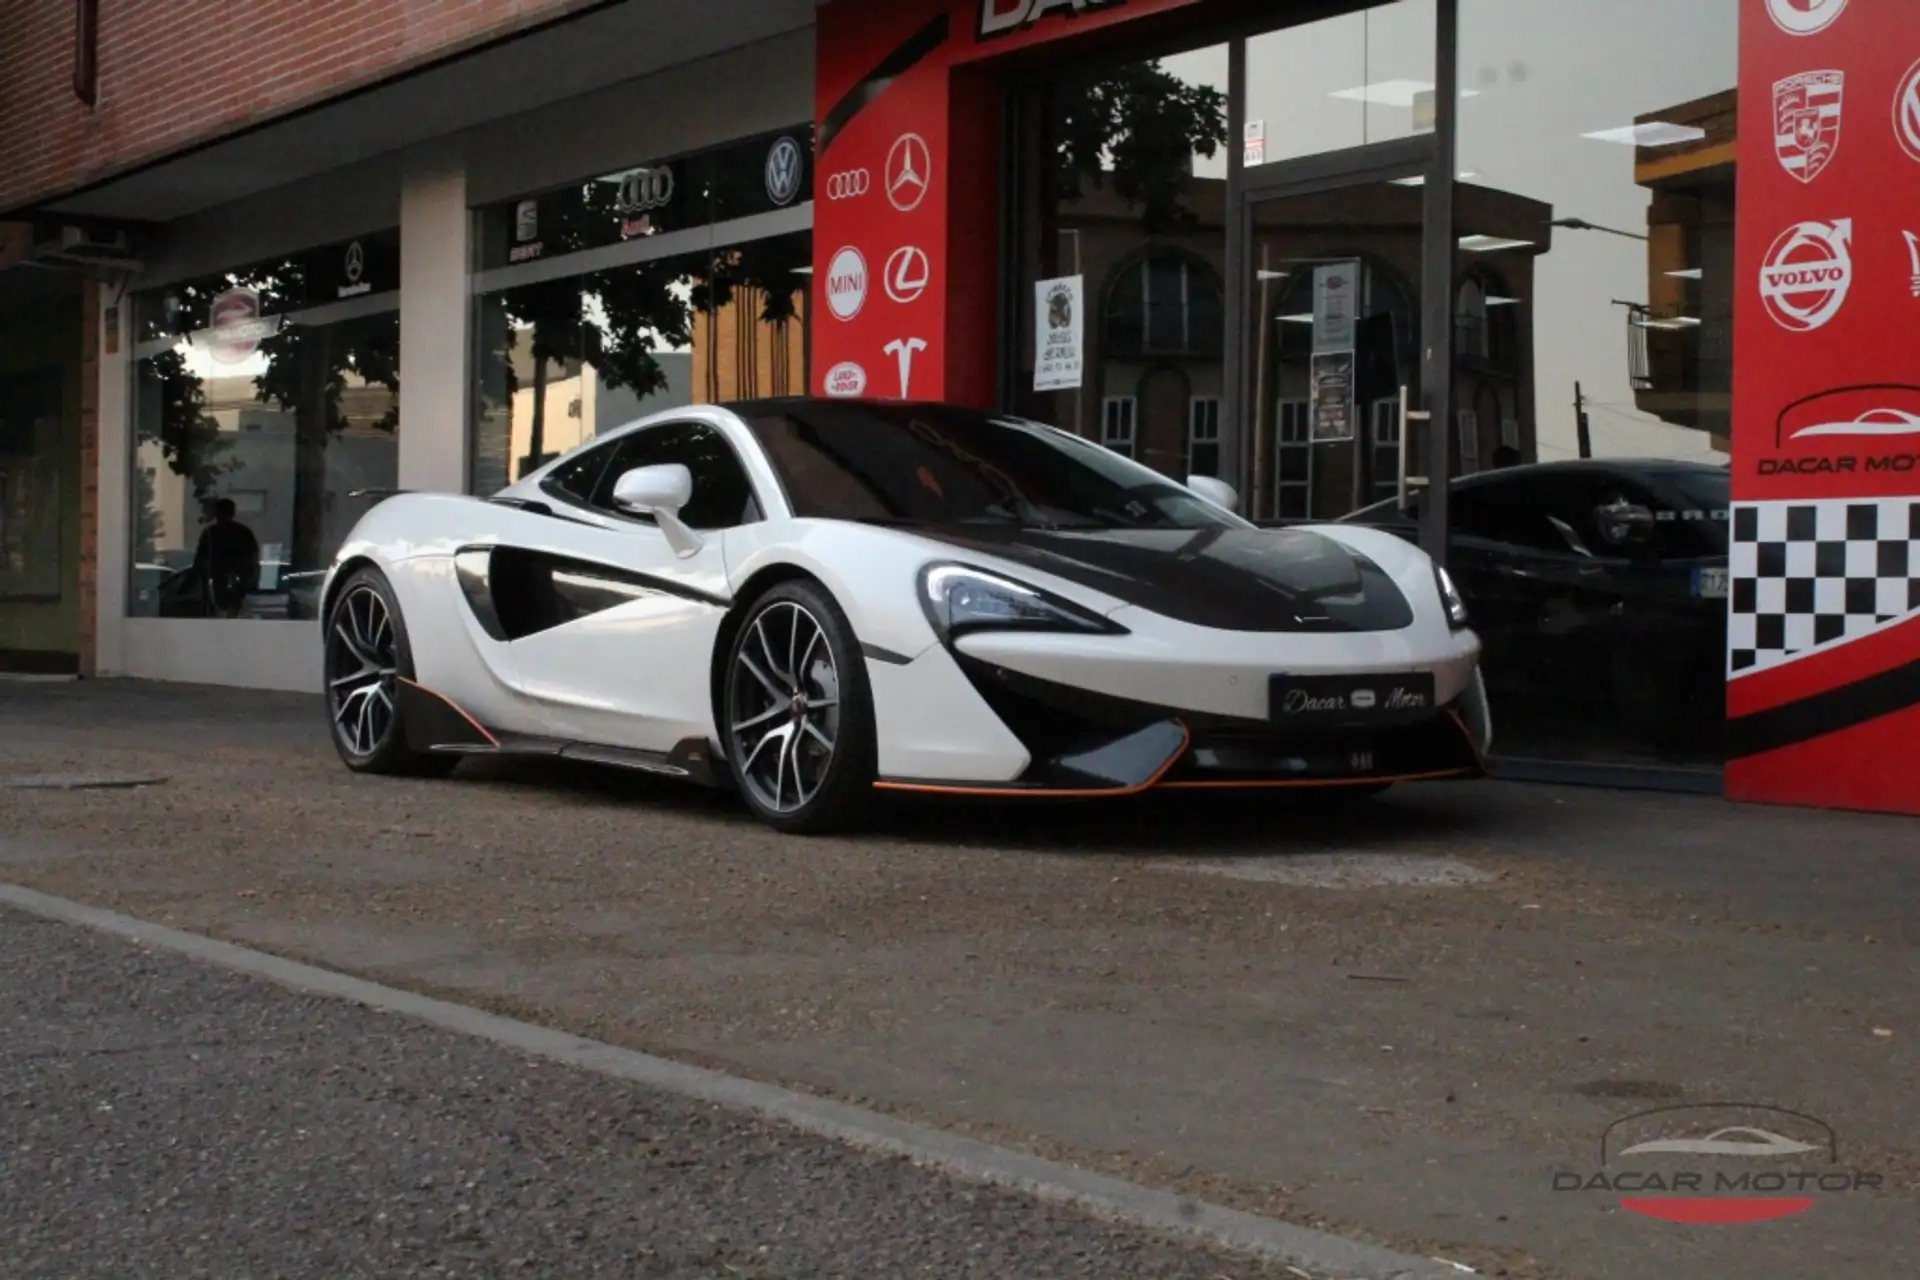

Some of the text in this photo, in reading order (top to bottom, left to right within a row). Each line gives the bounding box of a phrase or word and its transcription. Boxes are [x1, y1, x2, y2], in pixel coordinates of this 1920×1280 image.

[830, 272, 863, 296] MINI
[1766, 267, 1844, 288] VOLVO
[1757, 452, 1920, 476] DACAR MO
[1281, 687, 1427, 713] Dacar Motor
